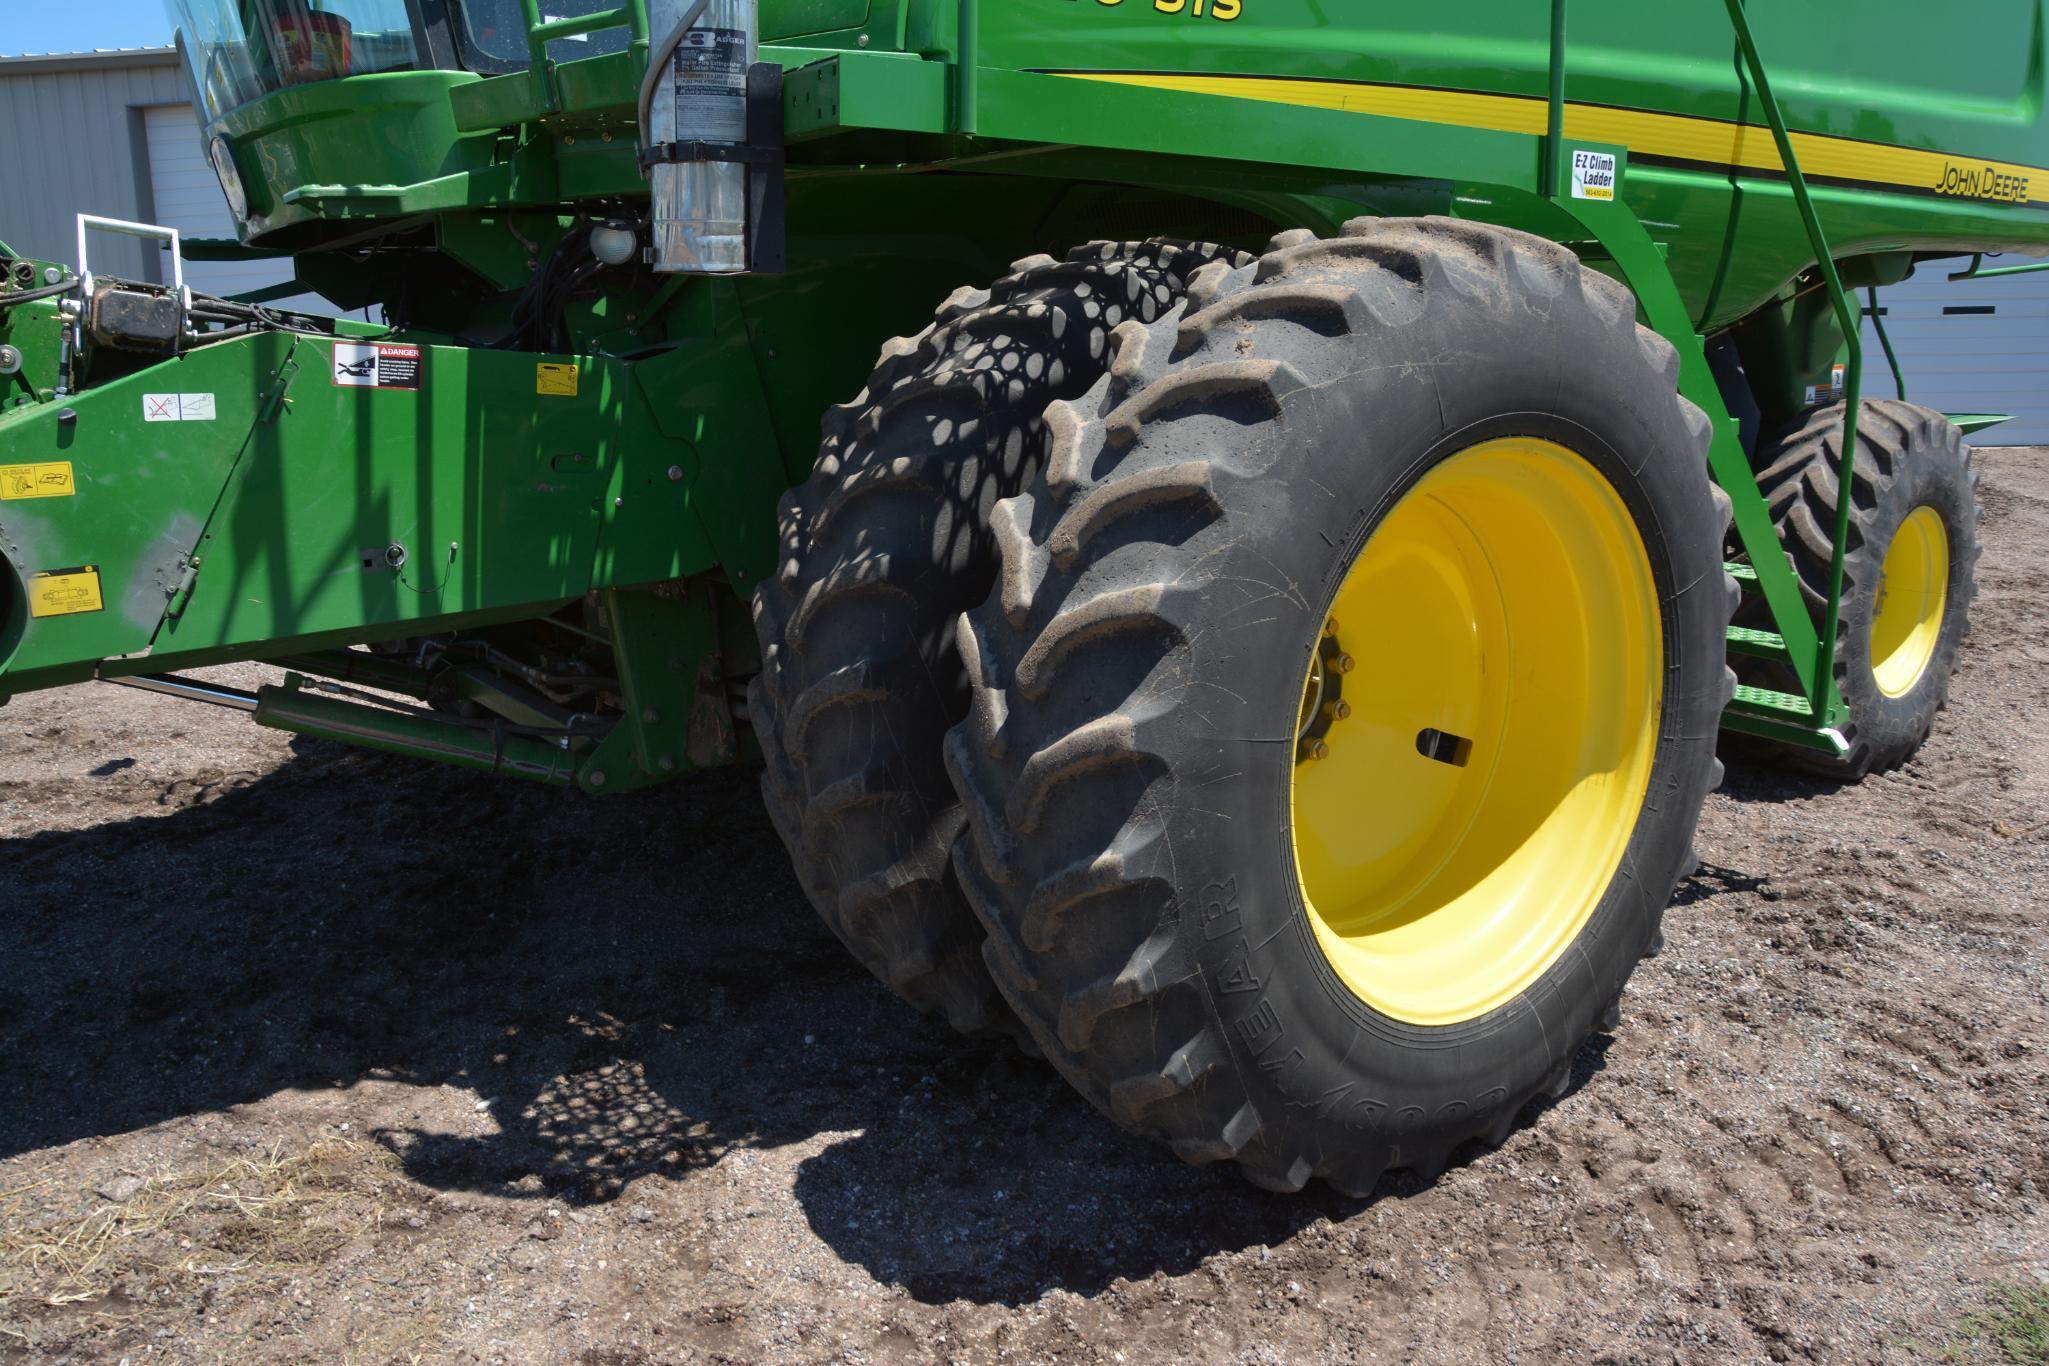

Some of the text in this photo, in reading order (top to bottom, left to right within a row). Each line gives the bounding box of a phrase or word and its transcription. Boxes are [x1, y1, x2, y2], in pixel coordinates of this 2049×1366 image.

[1575, 153, 1613, 171] E-Z Climb
[1583, 170, 1612, 187] Ladder
[1935, 161, 2029, 200] JOHN DEERE
[387, 347, 419, 357] DANGER
